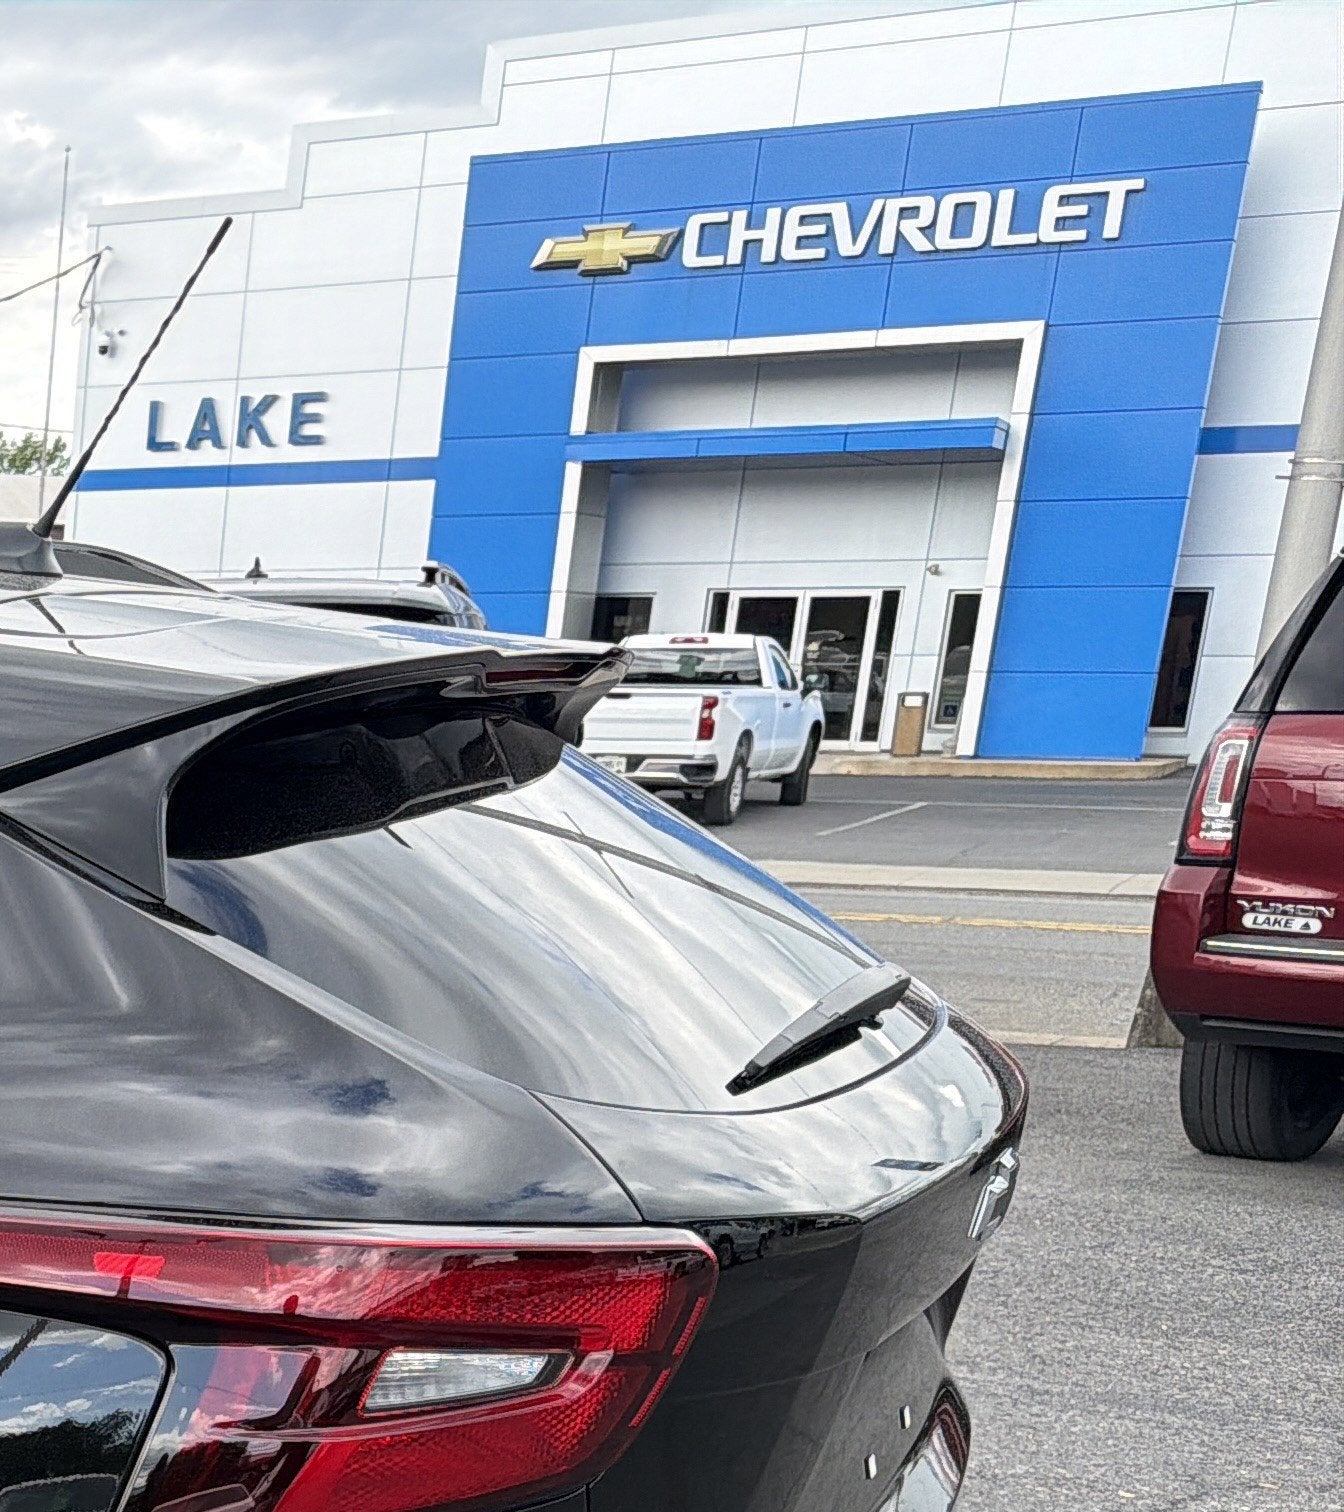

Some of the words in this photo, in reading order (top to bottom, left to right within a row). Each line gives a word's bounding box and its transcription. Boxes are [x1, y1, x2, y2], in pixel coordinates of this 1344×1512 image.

[682, 177, 1146, 270] CHEVROLET
[146, 390, 331, 453] LAKE
[1236, 899, 1336, 919] YUKON
[1251, 915, 1296, 929] LAKE
